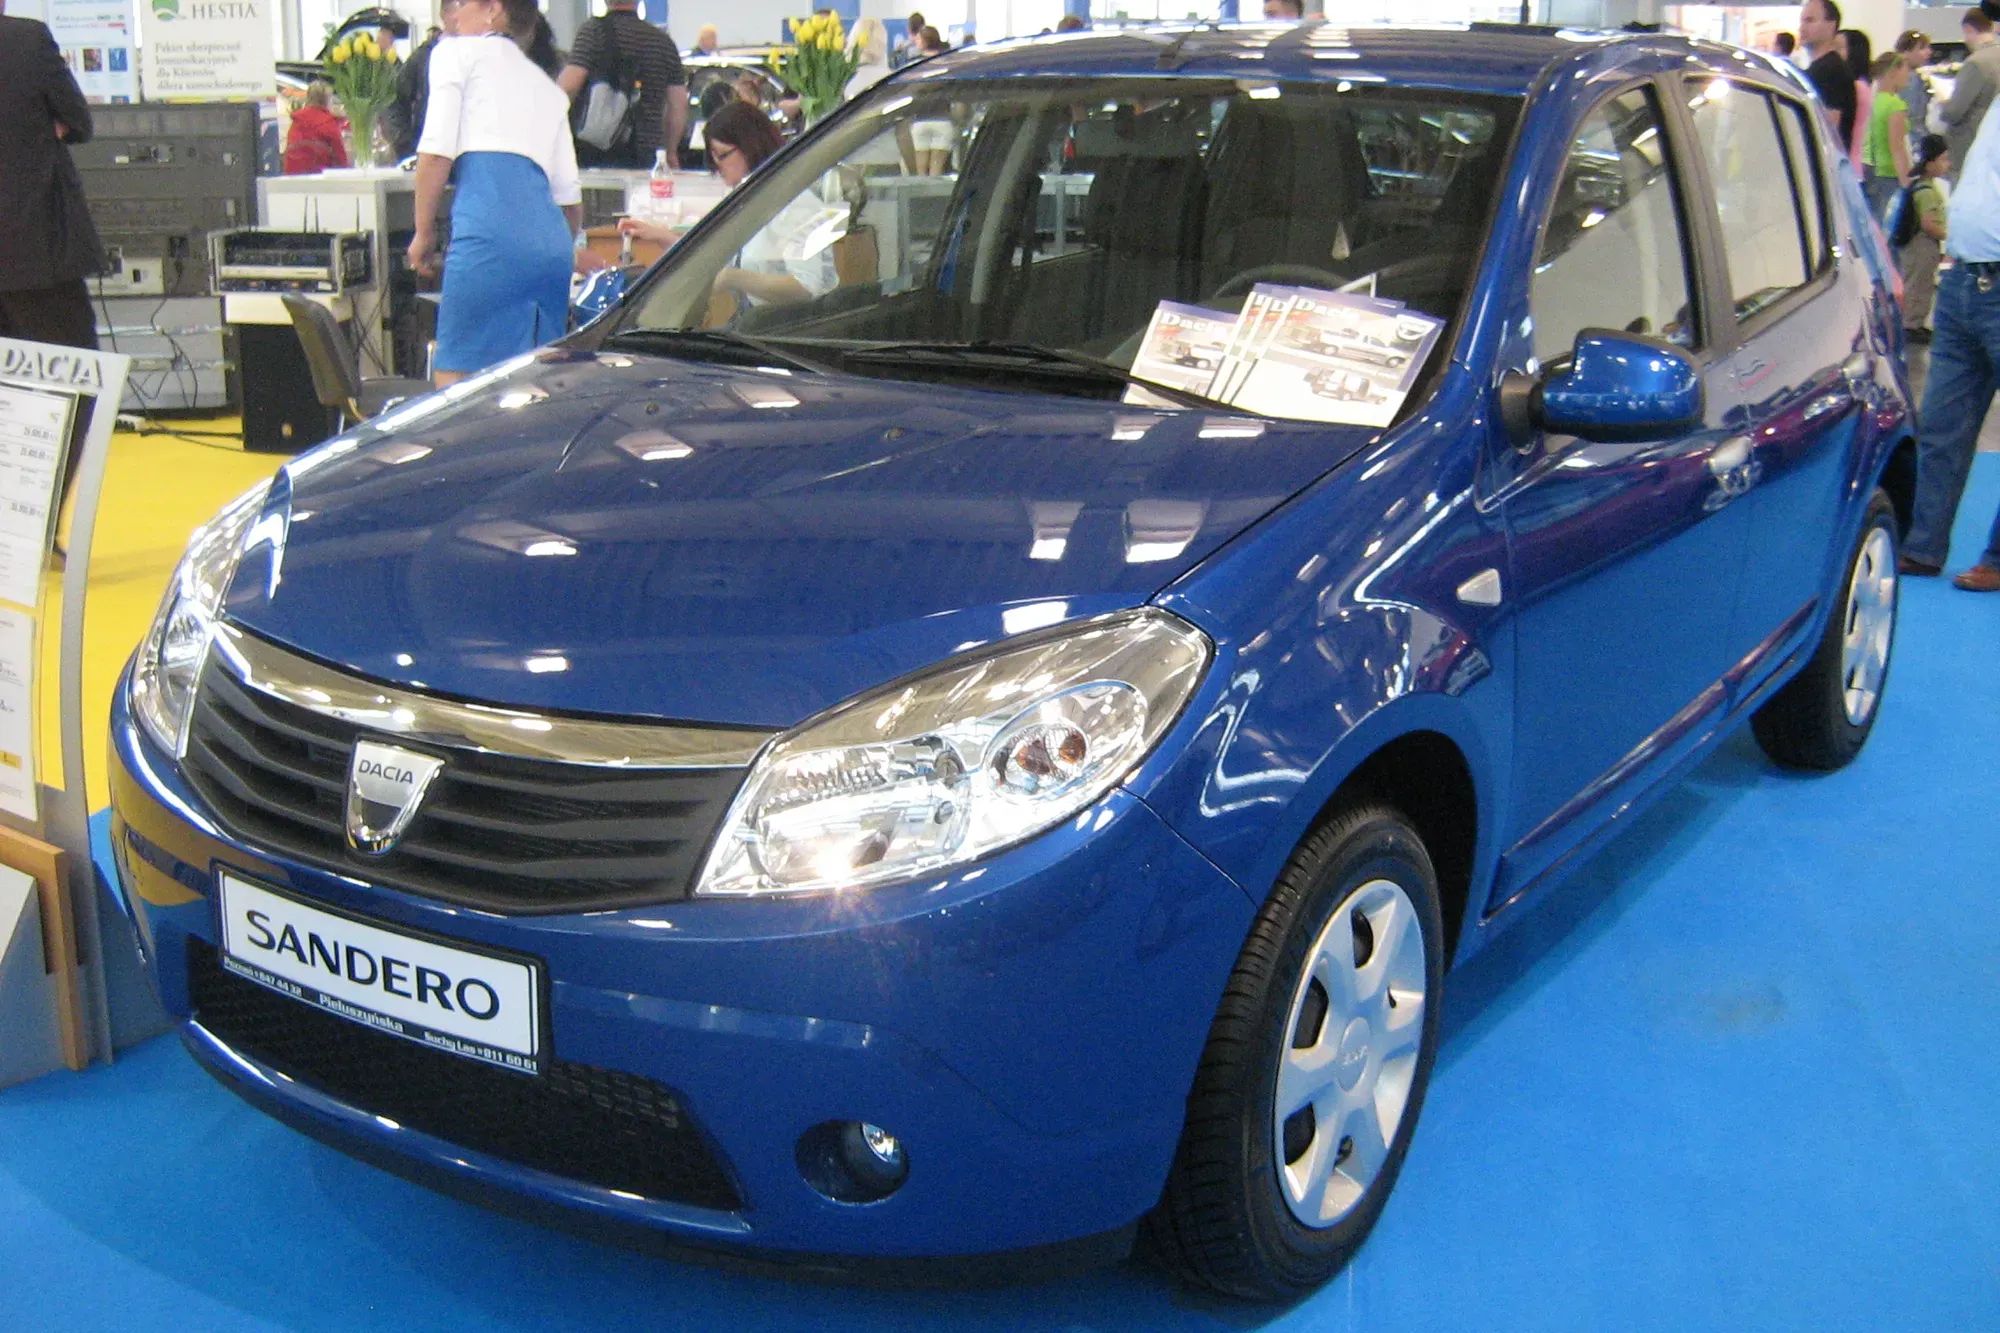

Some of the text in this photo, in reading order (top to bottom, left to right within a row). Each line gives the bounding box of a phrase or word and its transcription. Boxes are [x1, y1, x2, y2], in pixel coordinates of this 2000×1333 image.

[191, 3, 257, 19] HESTIA
[3, 348, 102, 387] DACIA
[358, 759, 413, 784] DACIA
[246, 909, 500, 1020] SANDERO
